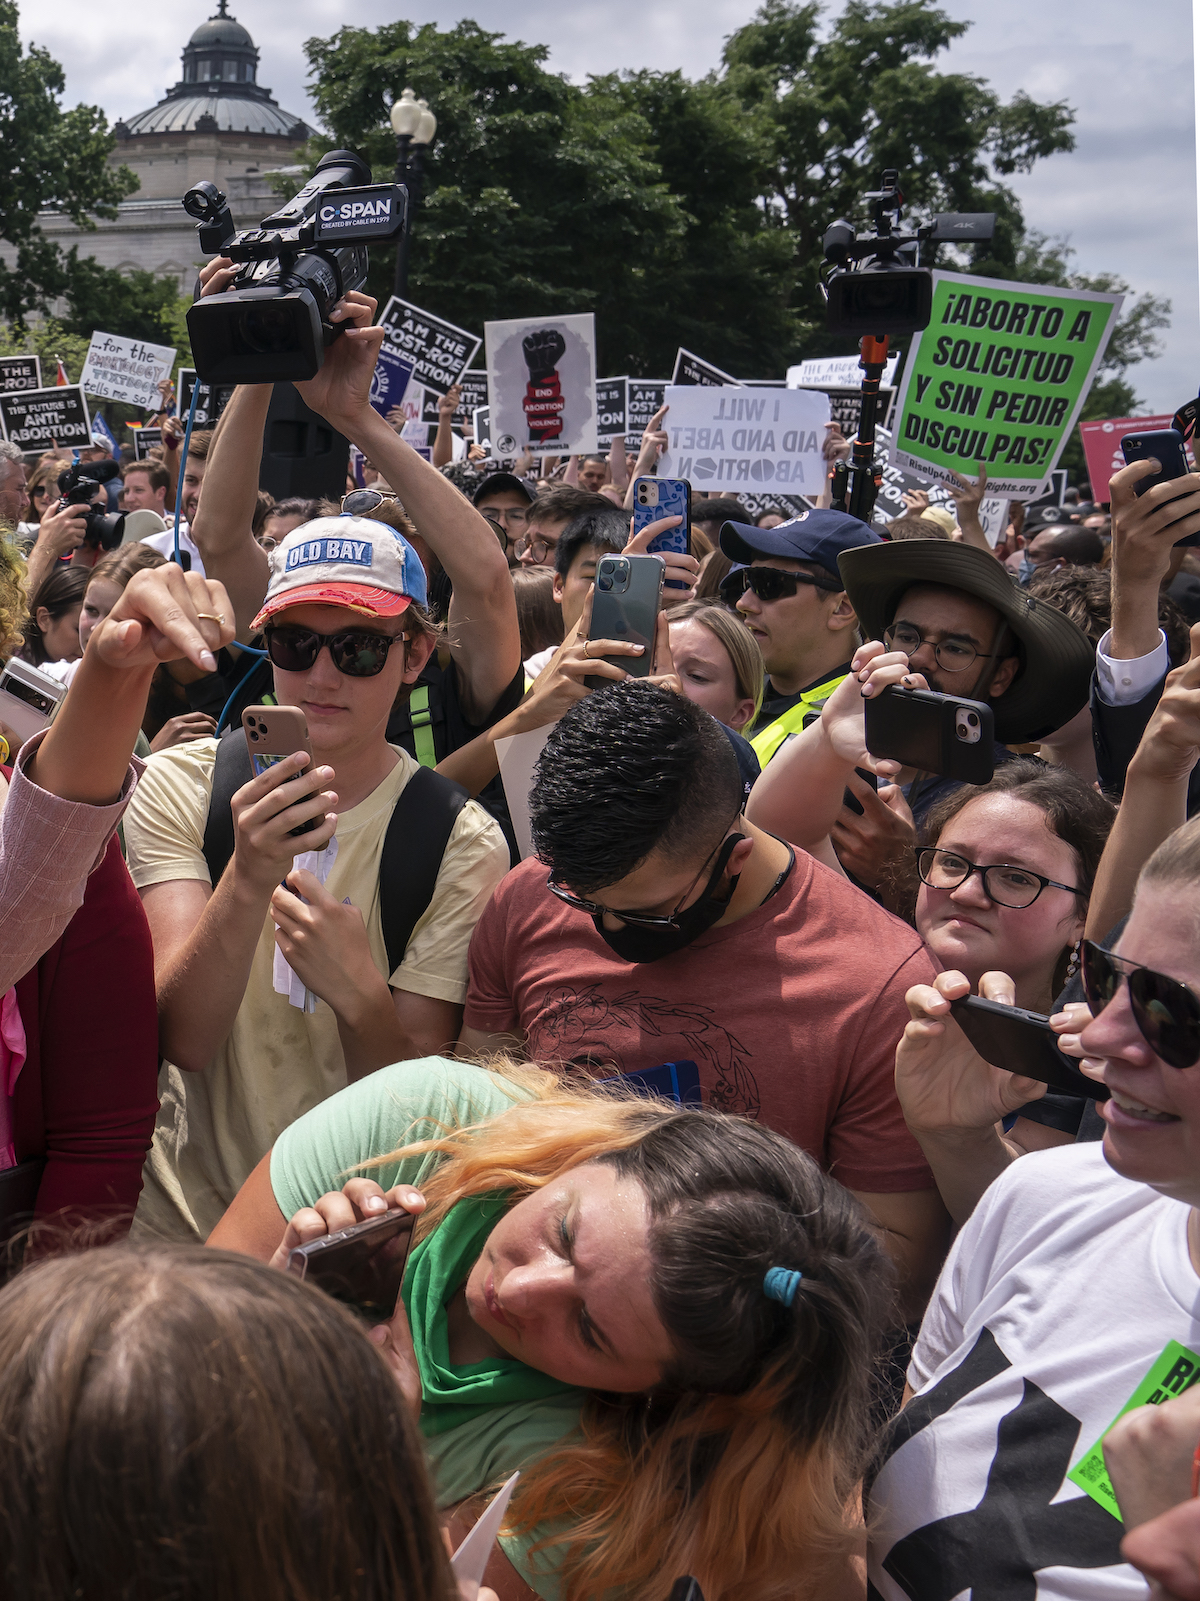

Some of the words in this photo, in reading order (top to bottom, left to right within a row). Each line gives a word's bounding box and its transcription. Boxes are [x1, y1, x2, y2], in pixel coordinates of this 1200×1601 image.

[321, 221, 345, 229] CREATED
[352, 218, 370, 226] CABLE
[941, 293, 1064, 339] ¡ABORTO
[1066, 310, 1092, 342] A
[382, 322, 466, 373] POST-ROE
[401, 318, 430, 338] AM
[434, 332, 467, 358] THE
[130, 343, 155, 363] the
[932, 335, 1074, 385] SOLICITUD
[1, 366, 31, 377] THE
[83, 378, 109, 396] tells
[112, 388, 128, 400] me
[535, 388, 553, 397] END
[7, 405, 27, 416] THE
[28, 401, 66, 414] FUTURE
[67, 399, 77, 409] IS
[524, 403, 564, 412] ABORTION
[915, 373, 933, 405] Y
[934, 380, 983, 417] SIN
[985, 389, 1070, 427] PEDIR
[24, 412, 66, 427] ANTI-
[528, 419, 561, 427] VIOLENCE
[10, 422, 87, 442] ABORTION
[904, 412, 1054, 466] DISCULPAS!
[289, 541, 322, 567] OLD
[326, 540, 367, 561] BAY
